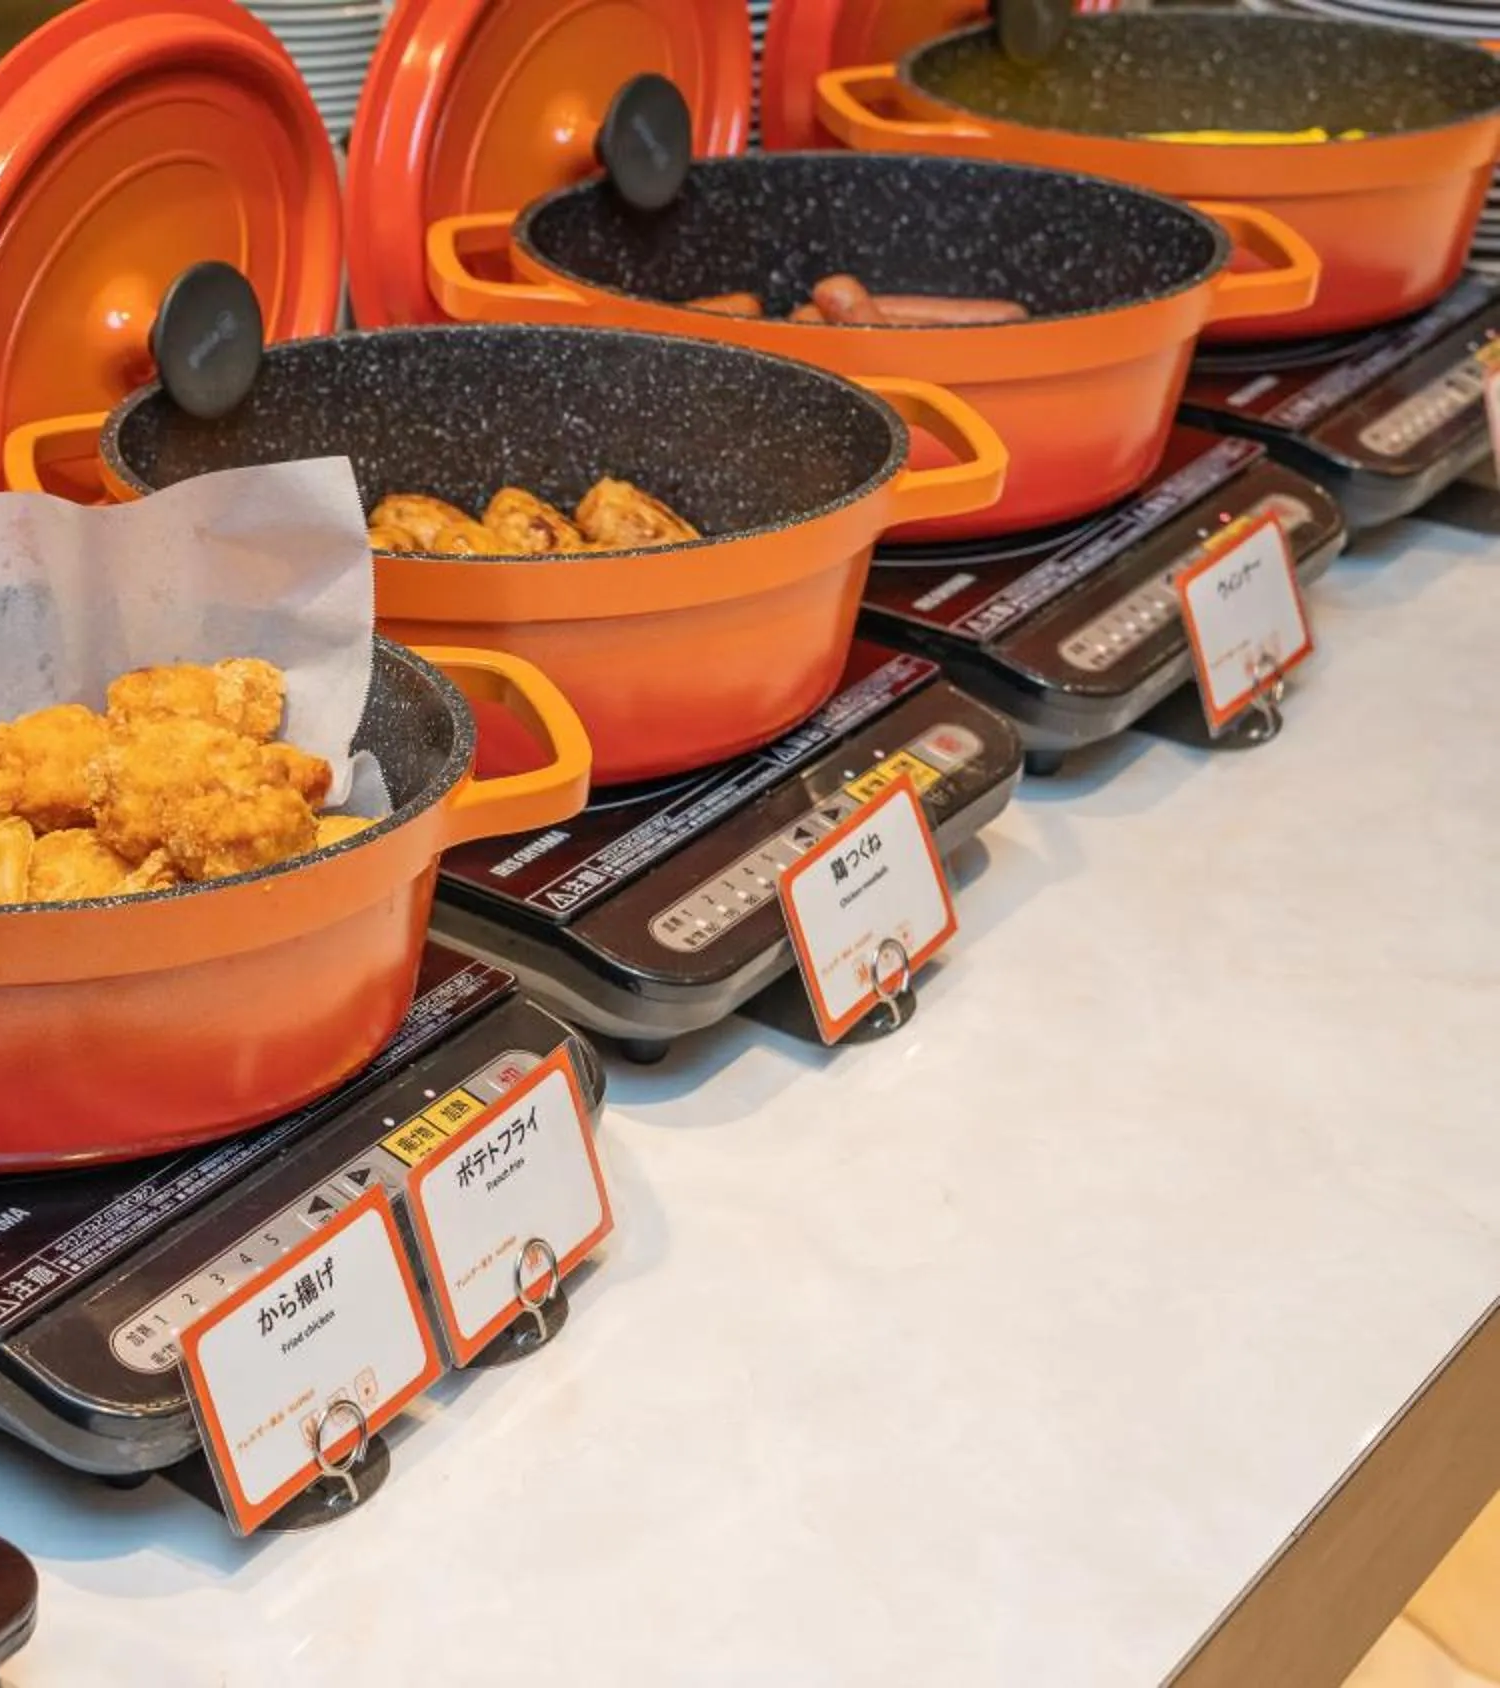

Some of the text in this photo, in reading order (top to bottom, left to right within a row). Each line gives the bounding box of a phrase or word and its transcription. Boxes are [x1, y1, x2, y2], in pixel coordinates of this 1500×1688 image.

[456, 1105, 538, 1189] ポテトフライ
[258, 1256, 334, 1337] から揚げ
